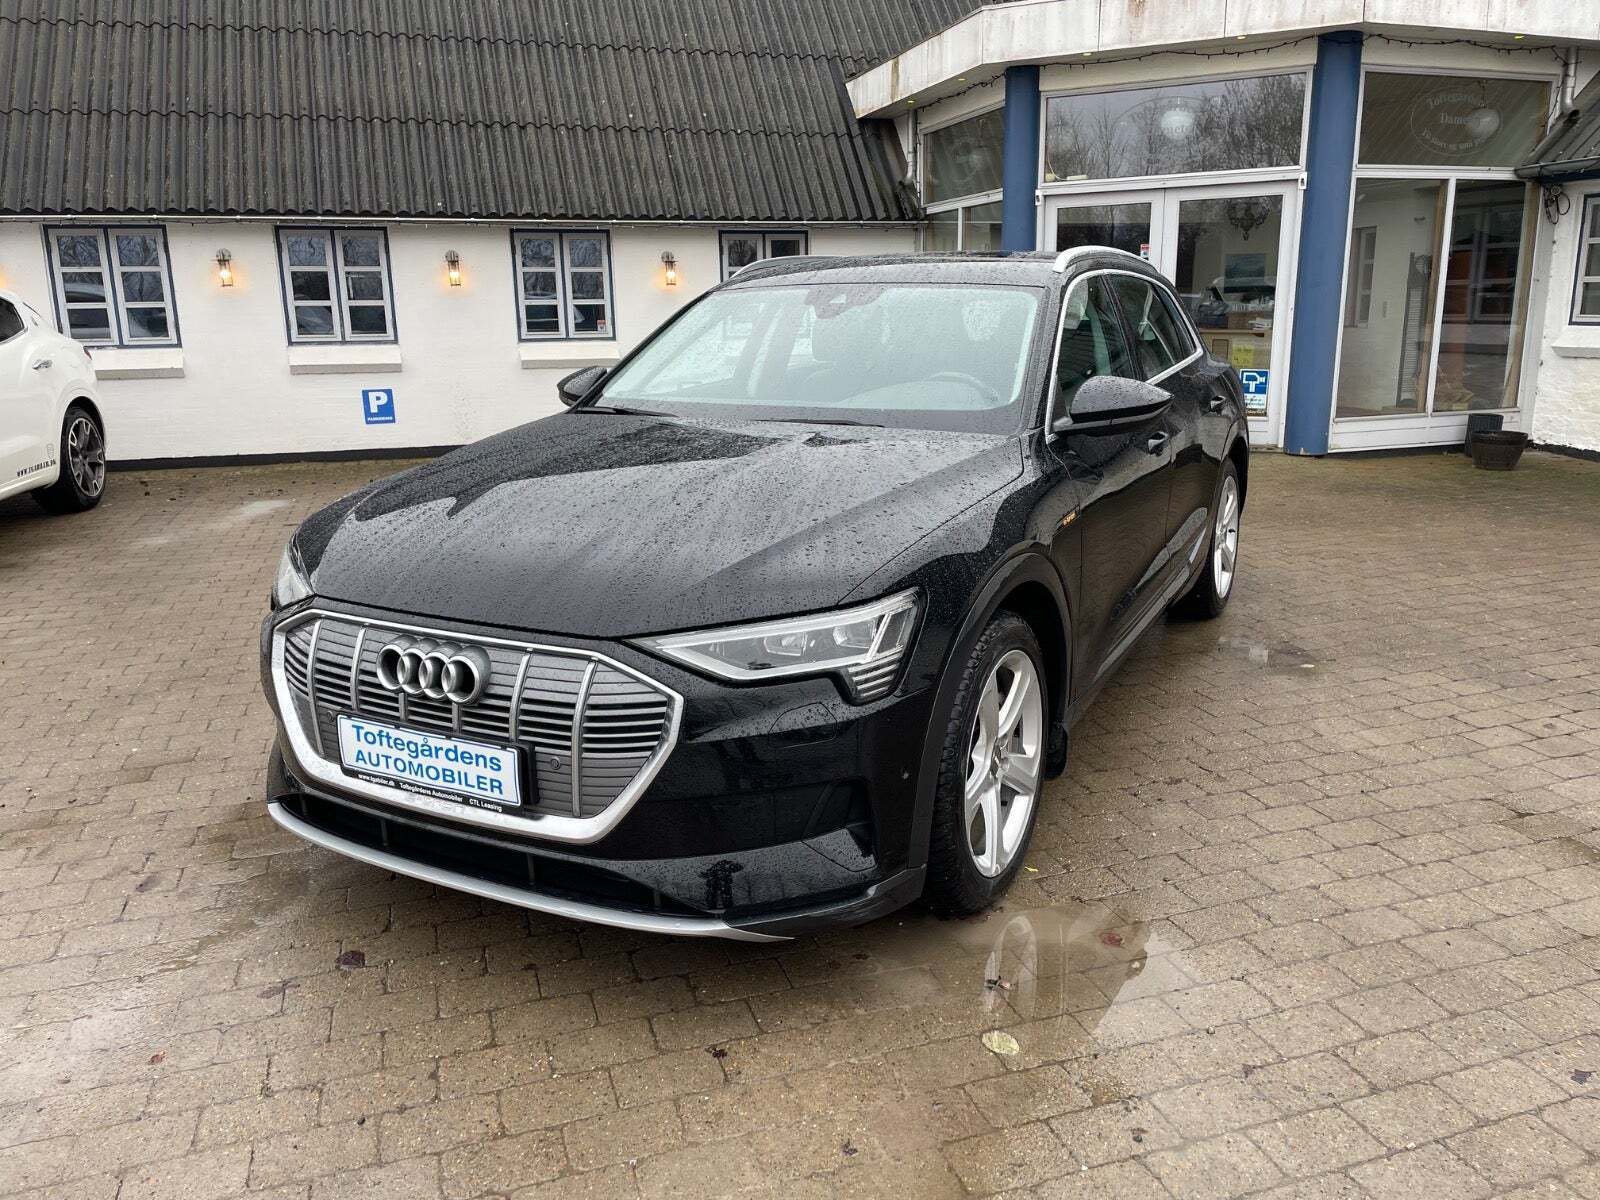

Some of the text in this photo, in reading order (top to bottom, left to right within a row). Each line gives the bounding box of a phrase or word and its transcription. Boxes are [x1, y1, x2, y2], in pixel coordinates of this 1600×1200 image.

[368, 391, 388, 413] P
[351, 723, 502, 772] Toftegårdens
[355, 749, 503, 795] AUTOMOBILER
[432, 790, 463, 802] Automobiler
[481, 801, 502, 812] Leasing
